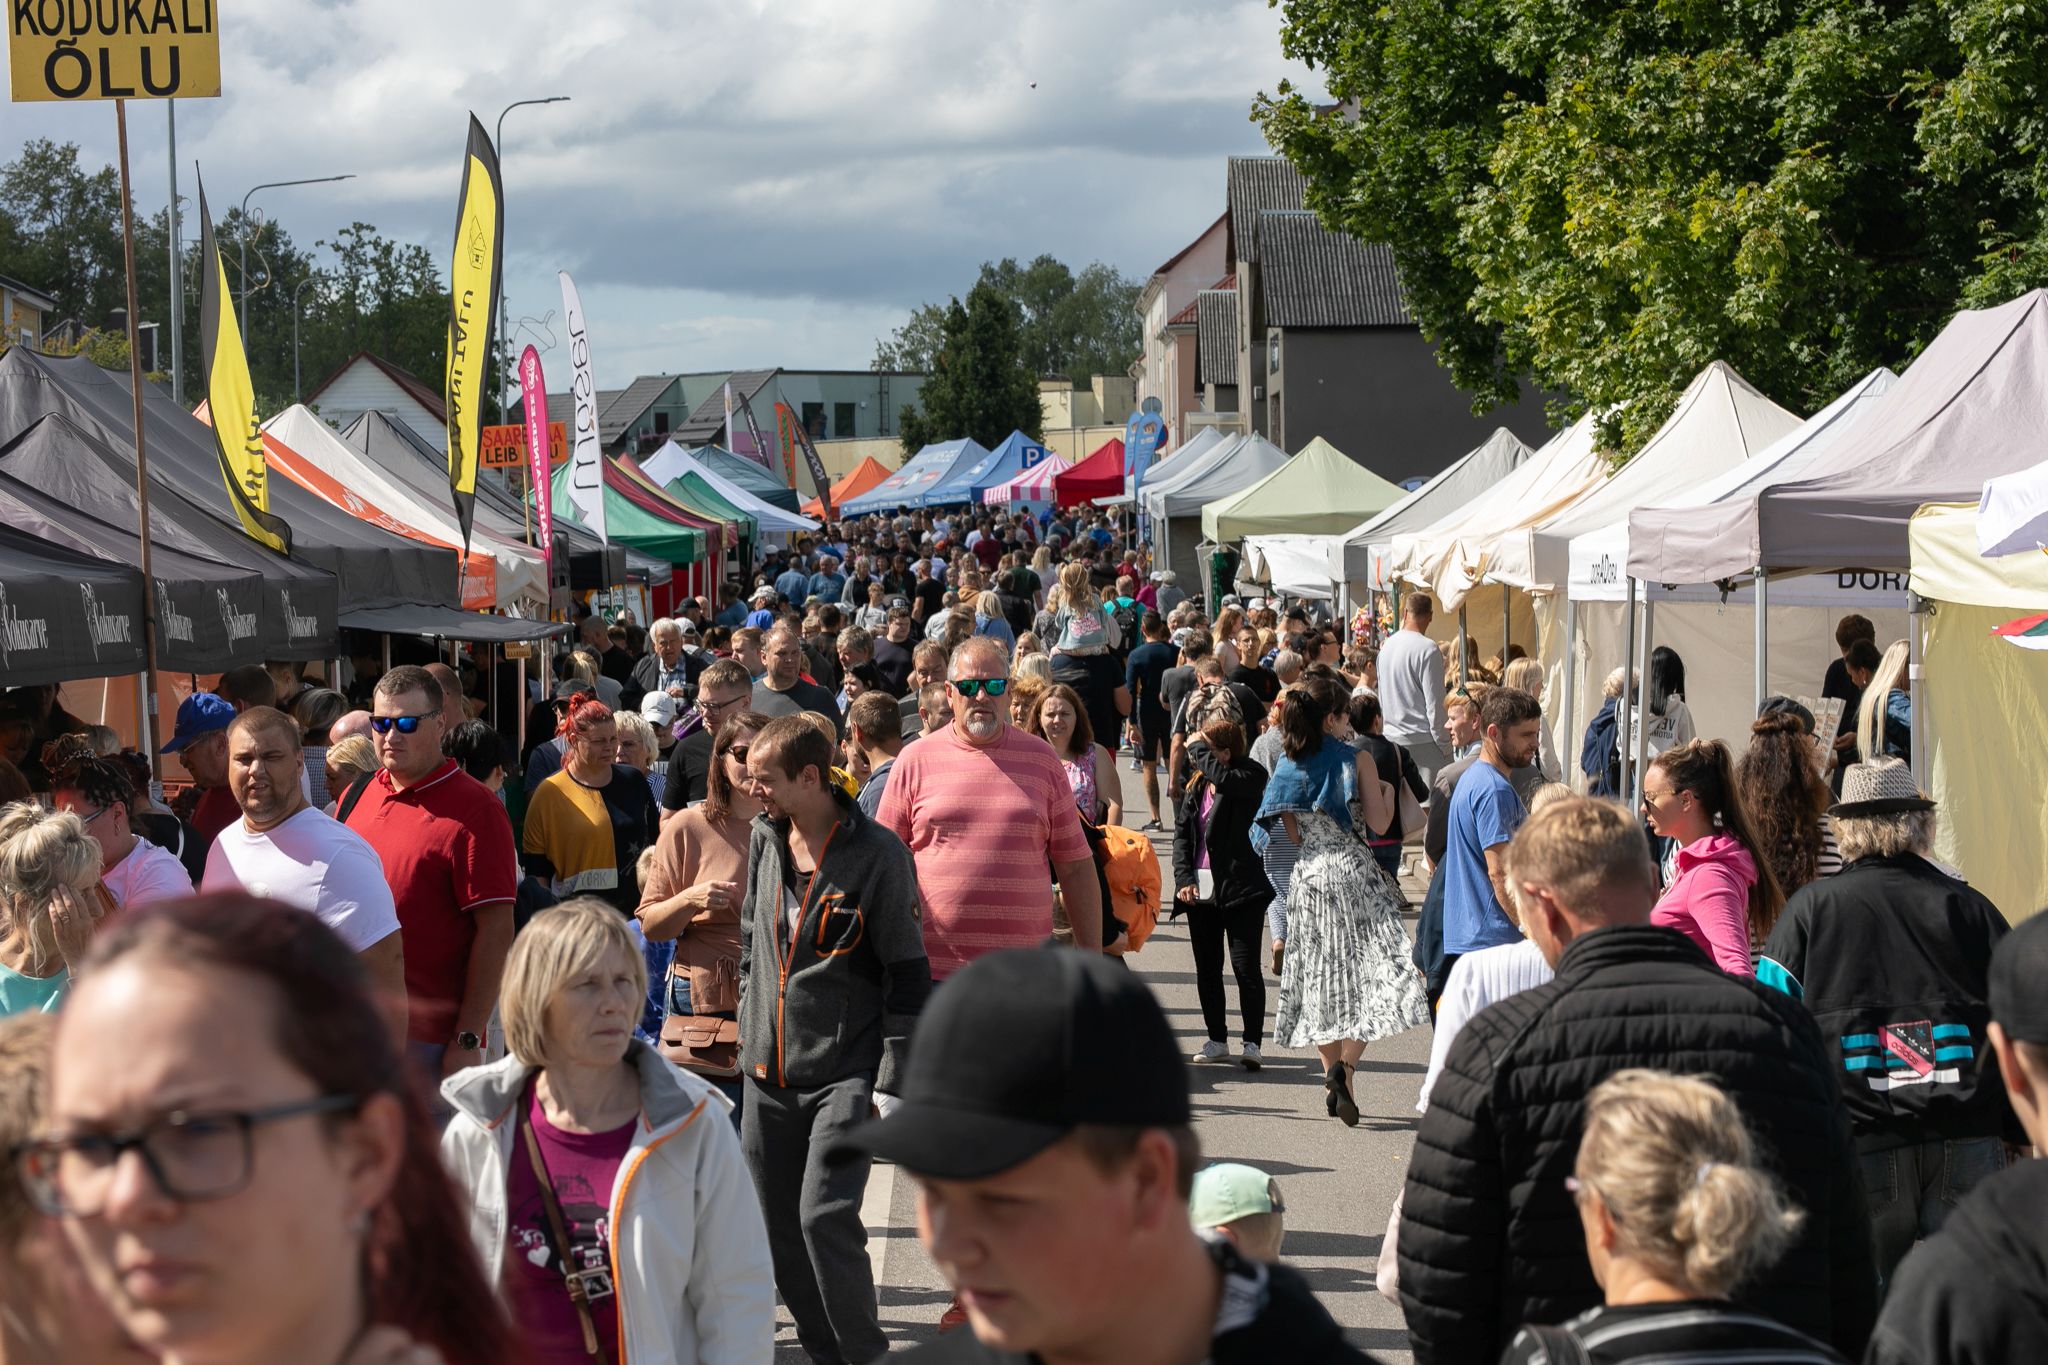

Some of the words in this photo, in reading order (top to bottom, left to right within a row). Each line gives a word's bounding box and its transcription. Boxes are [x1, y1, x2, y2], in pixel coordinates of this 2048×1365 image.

[15, 0, 212, 36] KODUKALI
[44, 37, 180, 98] ÕLU
[483, 426, 562, 448] SAAREA
[486, 446, 518, 463] LEIB
[1026, 448, 1040, 467] P
[580, 872, 607, 887] YORK
[1891, 1041, 1919, 1065] adidas
